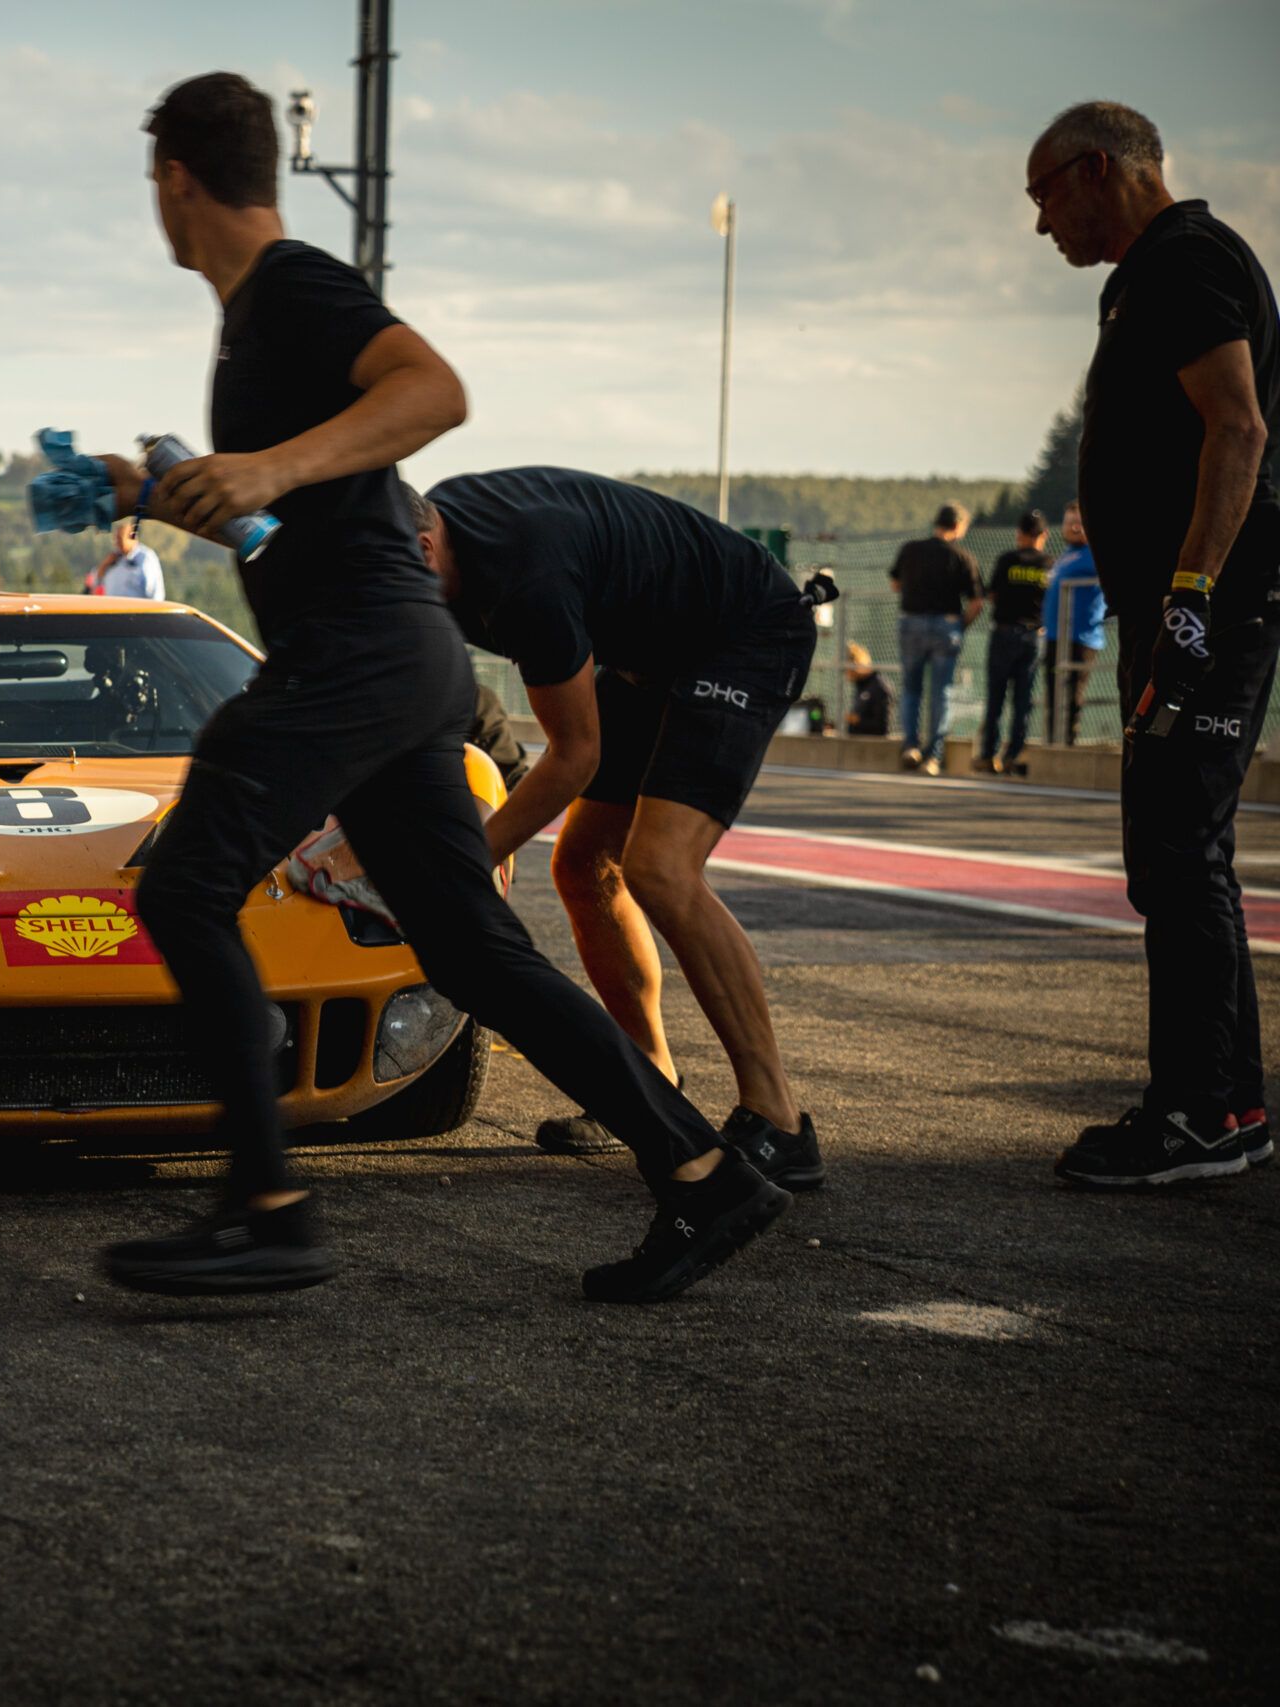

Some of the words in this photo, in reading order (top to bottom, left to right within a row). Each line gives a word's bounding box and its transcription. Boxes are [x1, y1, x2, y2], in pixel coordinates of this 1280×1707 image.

[693, 680, 749, 709] DHG
[1195, 715, 1241, 738] DHG
[29, 918, 125, 933] SHELL
